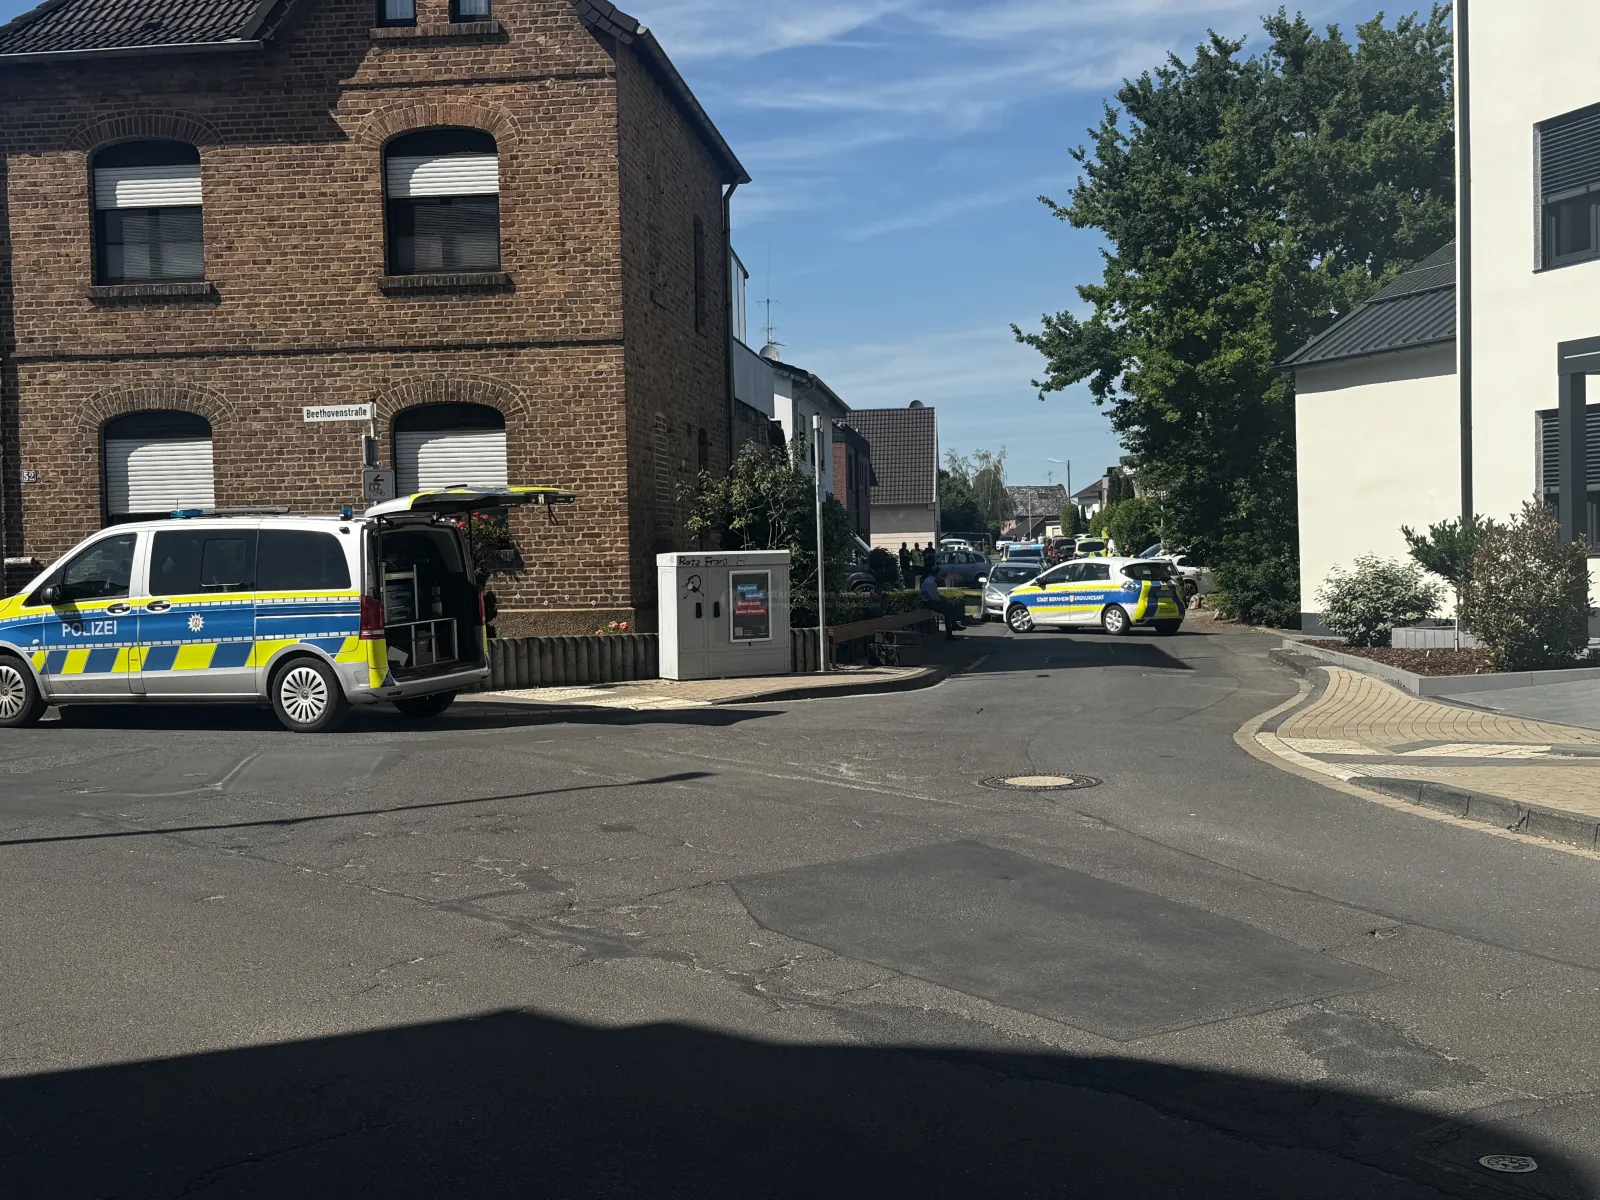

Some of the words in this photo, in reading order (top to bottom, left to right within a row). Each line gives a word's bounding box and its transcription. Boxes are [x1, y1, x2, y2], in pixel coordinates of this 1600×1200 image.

[306, 407, 367, 419] Beethovenstraße
[23, 472, 35, 481] 52
[62, 620, 117, 638] POLIZEI
